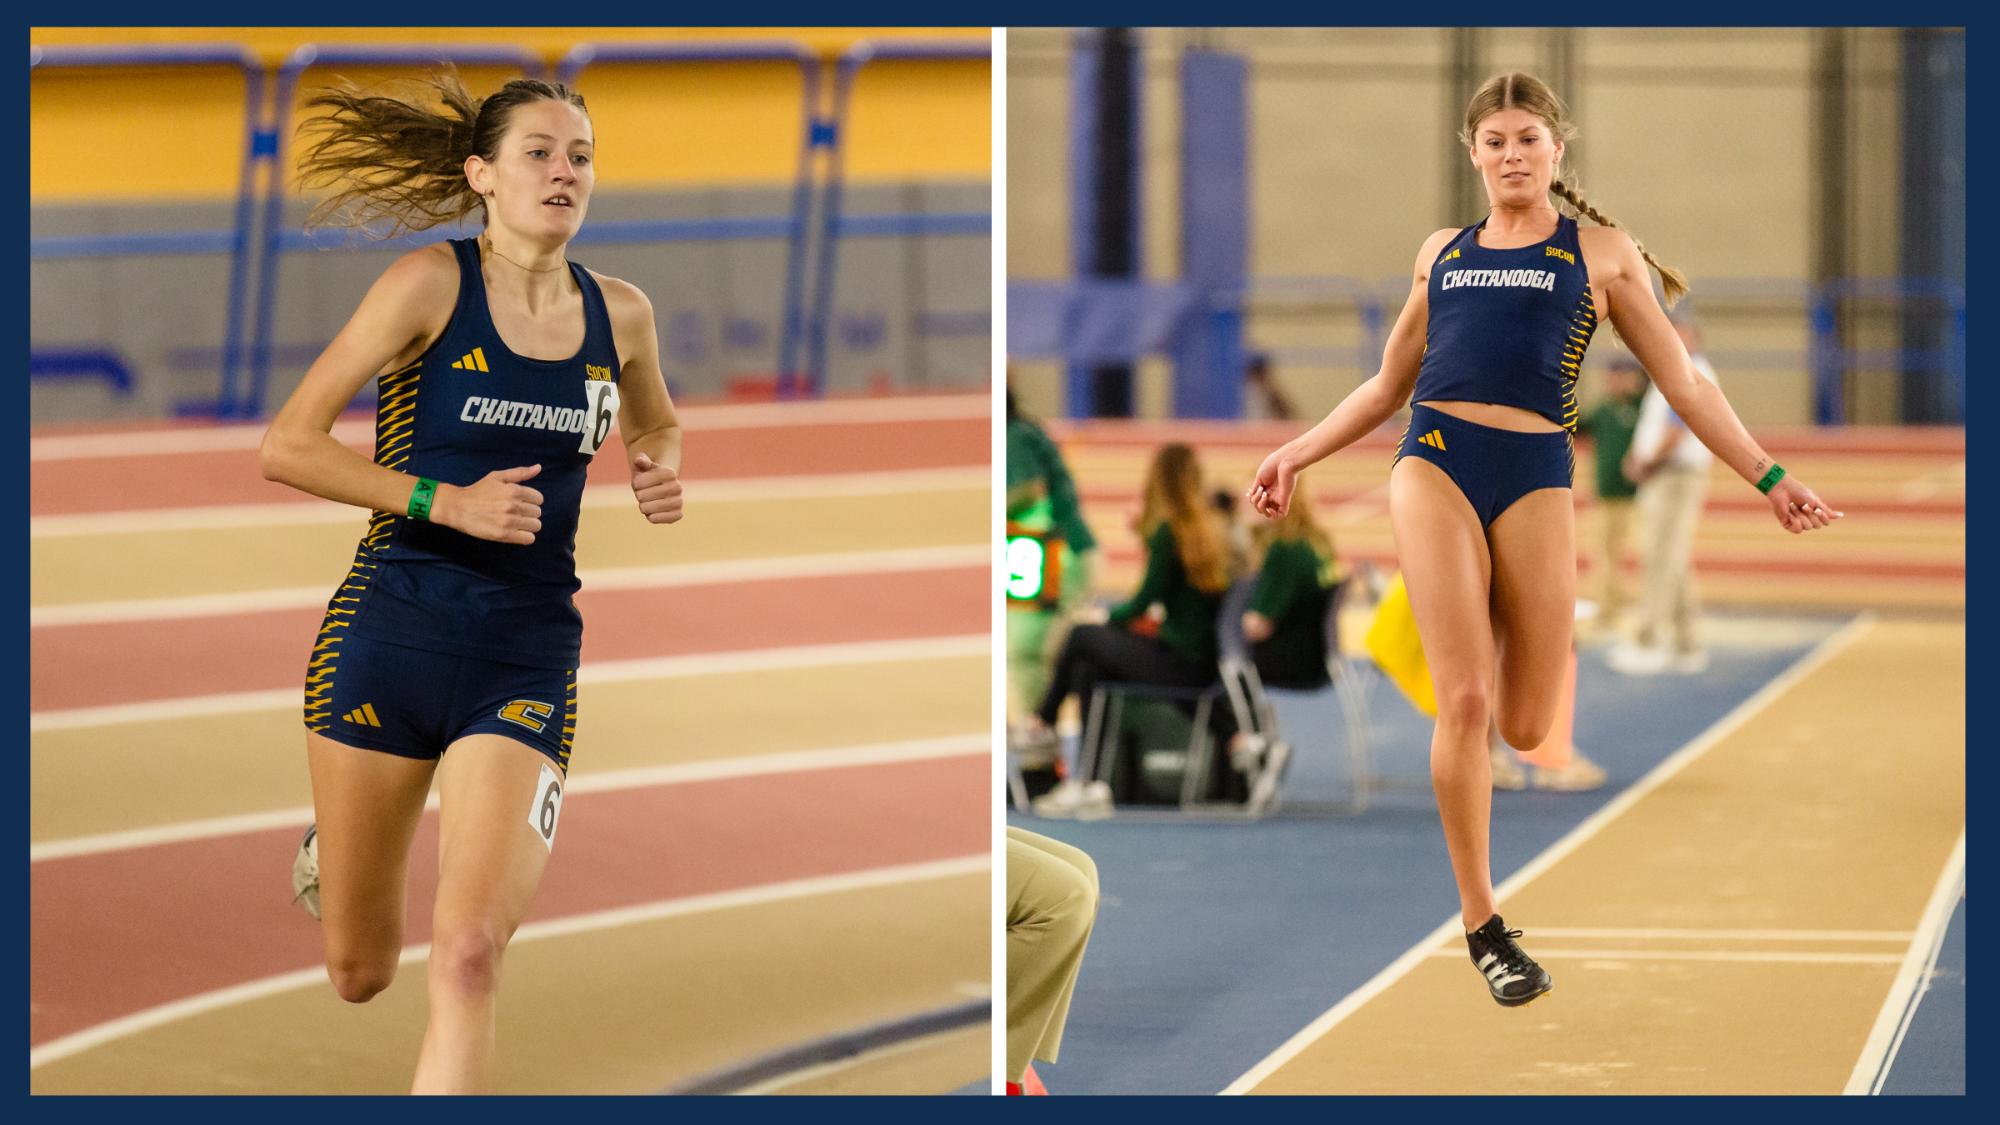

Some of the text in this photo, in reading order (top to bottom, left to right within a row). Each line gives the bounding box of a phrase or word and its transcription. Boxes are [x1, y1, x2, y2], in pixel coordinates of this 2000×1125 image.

[1442, 269, 1556, 292] CHATTANOOGA
[592, 384, 612, 452] 6
[1006, 537, 1043, 599] 9
[540, 780, 561, 840] 6
